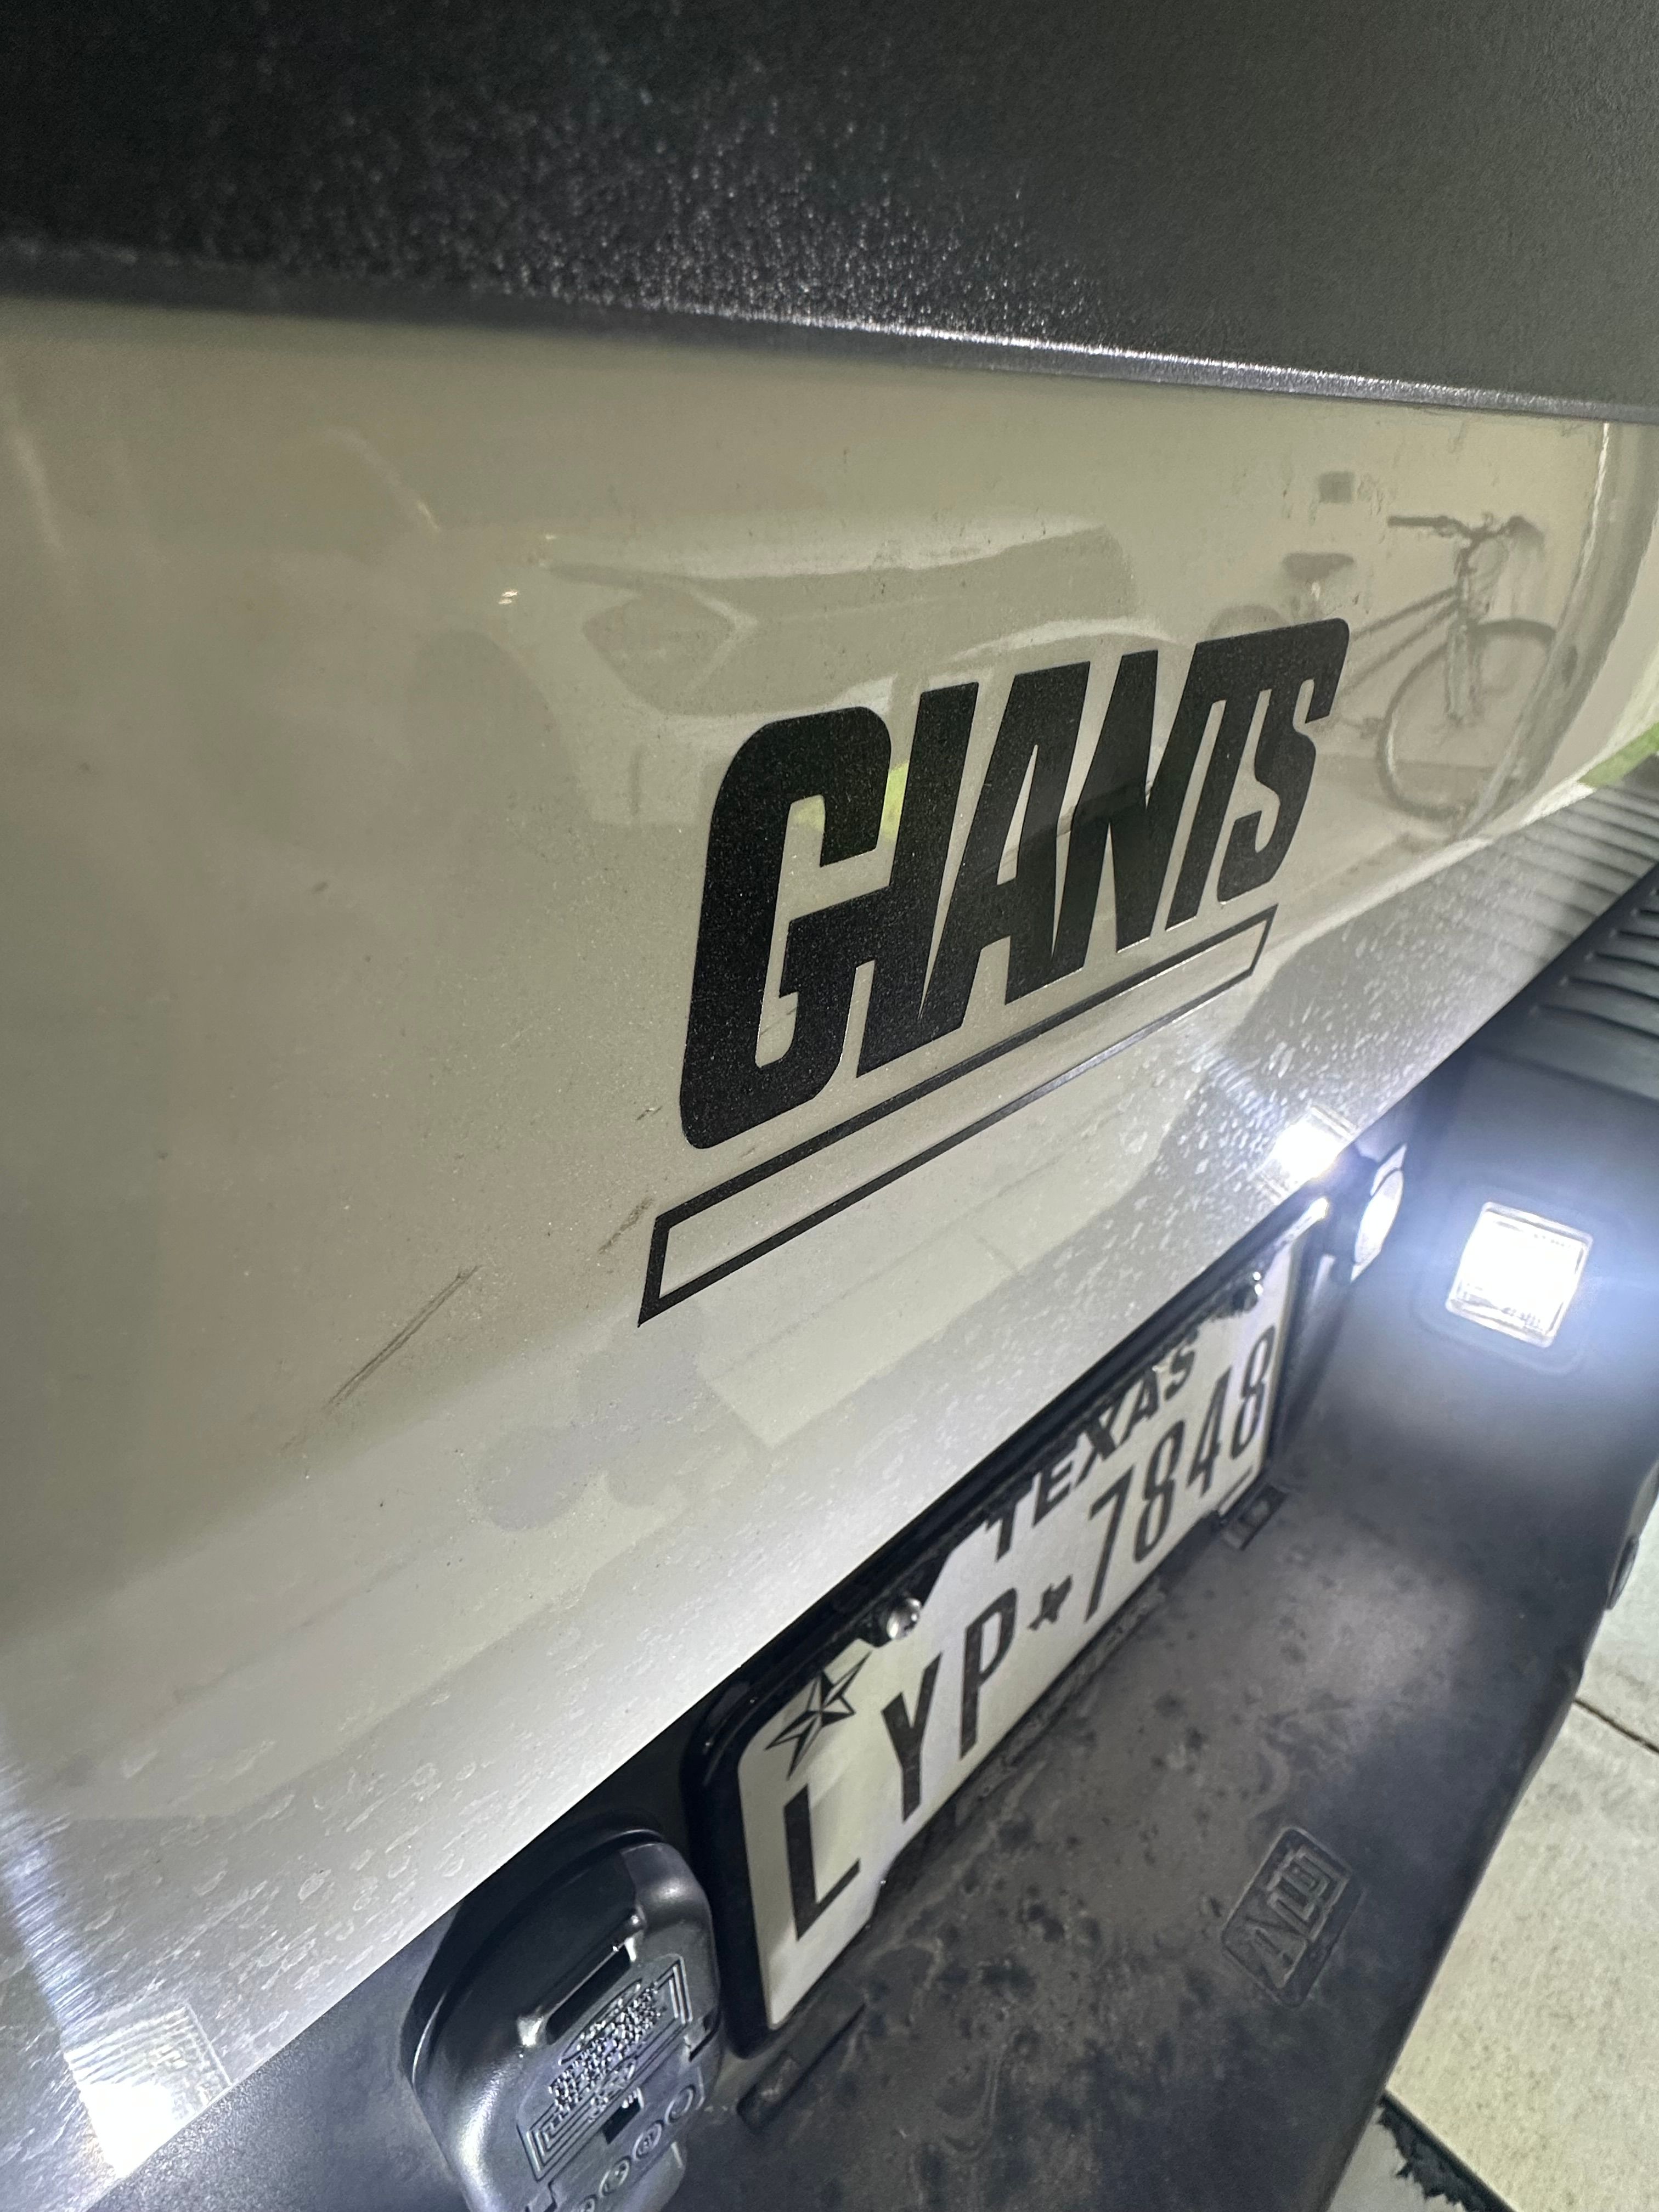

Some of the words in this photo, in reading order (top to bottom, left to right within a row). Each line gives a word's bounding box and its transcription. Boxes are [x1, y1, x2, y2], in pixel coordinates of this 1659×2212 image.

[679, 618, 1350, 1149] GIANTS
[783, 1587, 1017, 1942] LYP
[1084, 1325, 1275, 1623] 7848
[985, 1339, 1197, 1562] TEXAS
